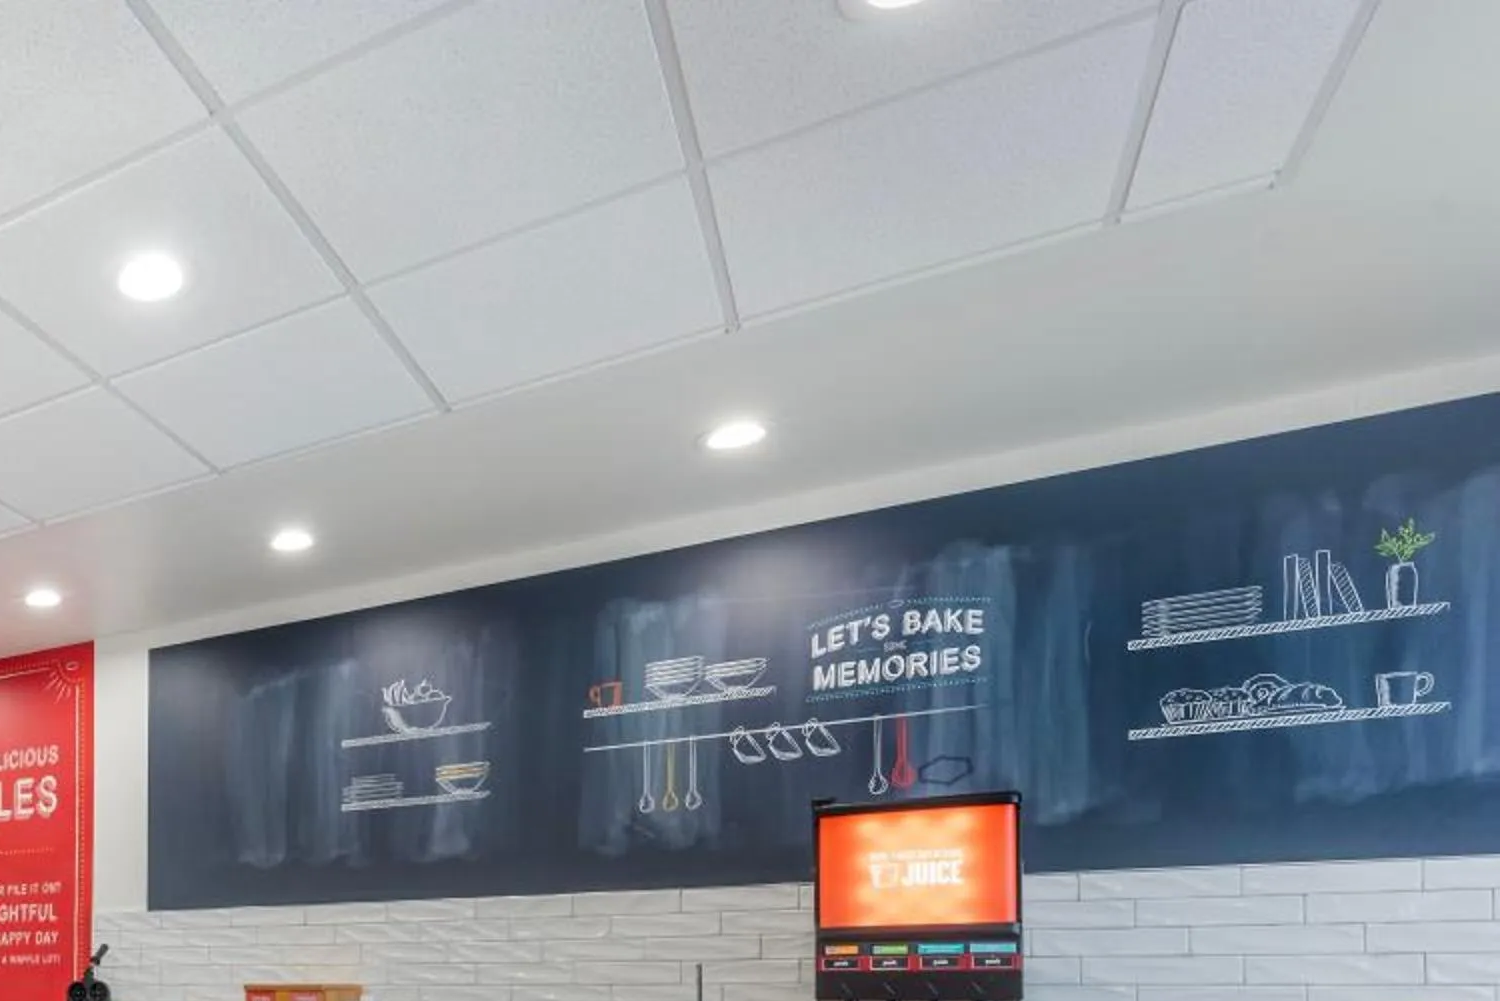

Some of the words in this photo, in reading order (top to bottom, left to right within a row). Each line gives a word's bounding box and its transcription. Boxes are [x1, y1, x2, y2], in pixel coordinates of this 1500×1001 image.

[811, 613, 891, 659] LET'S
[902, 608, 985, 636] BAKE
[812, 645, 982, 691] MEMORIES
[901, 859, 964, 886] JUICE
[35, 930, 59, 945] DAY
